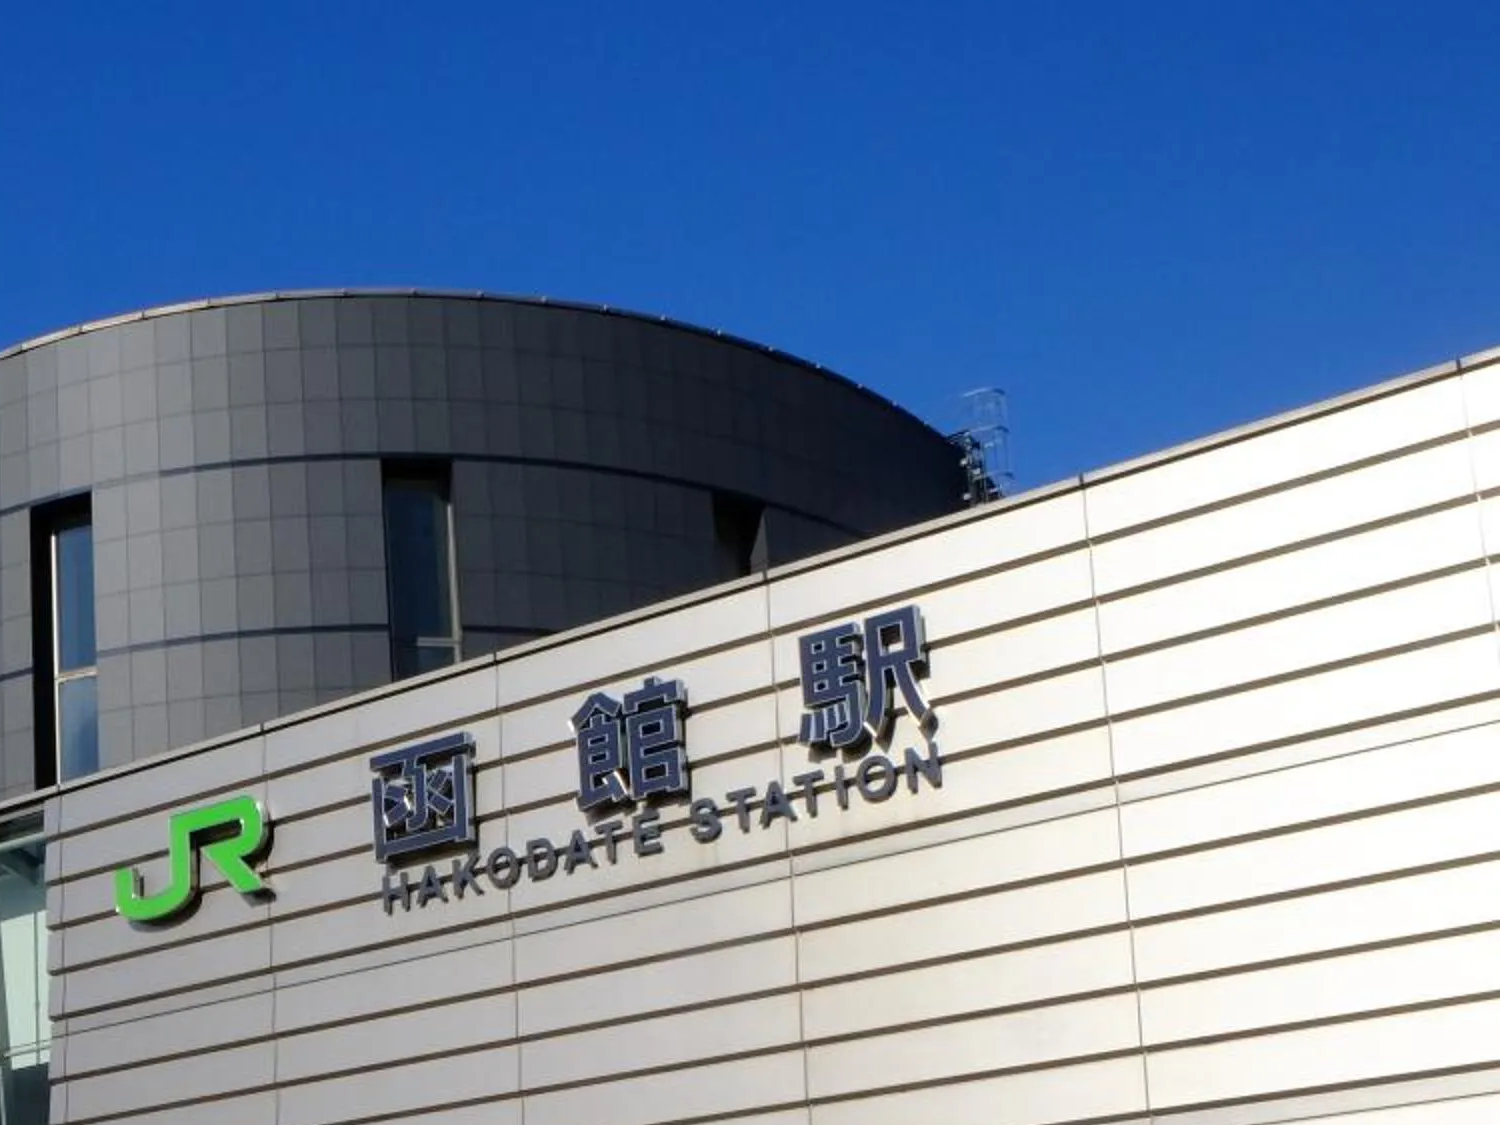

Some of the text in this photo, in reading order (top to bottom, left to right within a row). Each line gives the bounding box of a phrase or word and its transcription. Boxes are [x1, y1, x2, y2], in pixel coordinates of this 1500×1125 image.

[369, 604, 939, 863] 函館駅
[113, 793, 272, 923] JR
[381, 740, 944, 916] HAKODATE STATION
